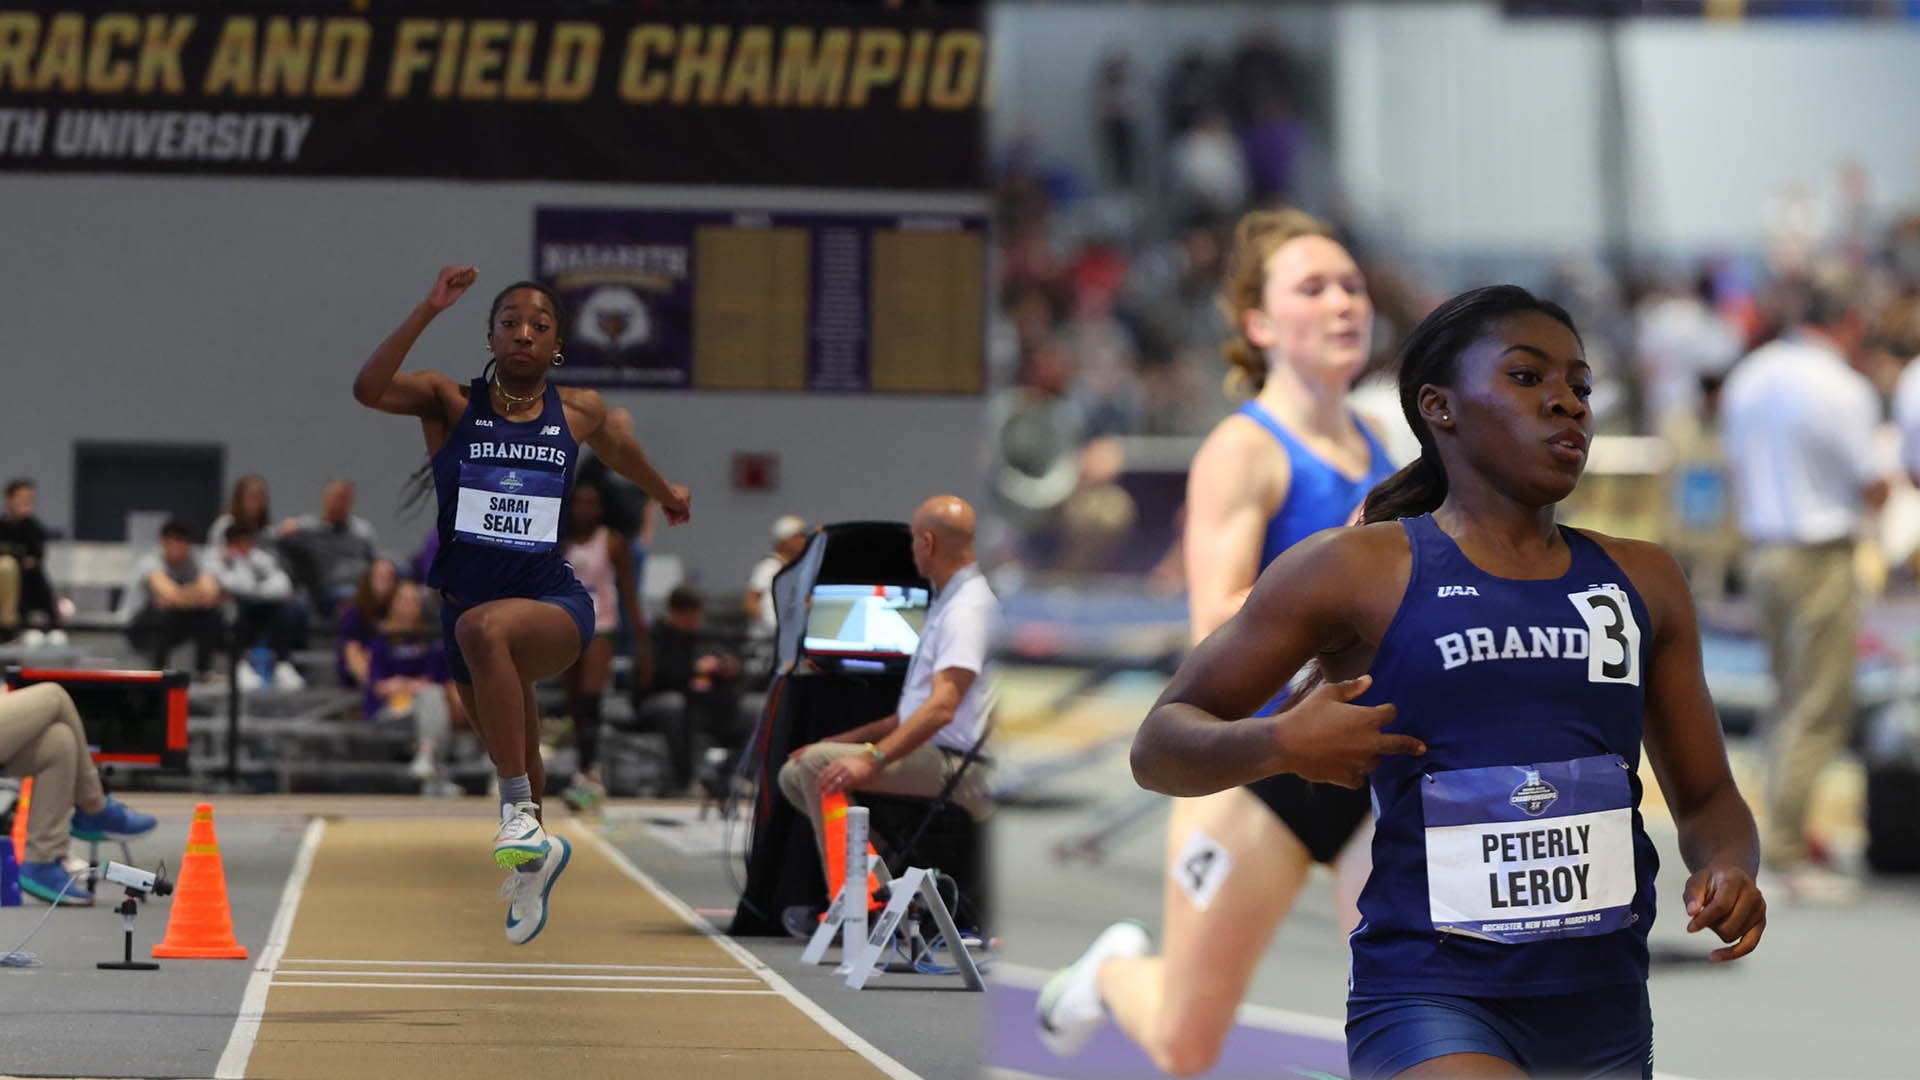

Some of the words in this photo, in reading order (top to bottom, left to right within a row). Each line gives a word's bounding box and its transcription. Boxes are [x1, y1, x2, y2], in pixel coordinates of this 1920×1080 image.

[204, 16, 372, 97] AND
[387, 20, 602, 101] FIELD
[618, 23, 998, 110] CHAMPIO
[55, 110, 312, 161] UNIVERSITY
[540, 425, 561, 436] NB
[469, 441, 567, 467] BRANDEIS
[489, 496, 530, 514] SARAI
[483, 513, 532, 535] SEALY
[1437, 585, 1480, 598] UAA
[1586, 594, 1631, 679] 3
[1481, 824, 1591, 863] PETERLY
[1185, 850, 1216, 893] 4
[1489, 863, 1590, 908] LEROY
[1525, 920, 1540, 929] NEW
[1542, 919, 1561, 928] YORK
